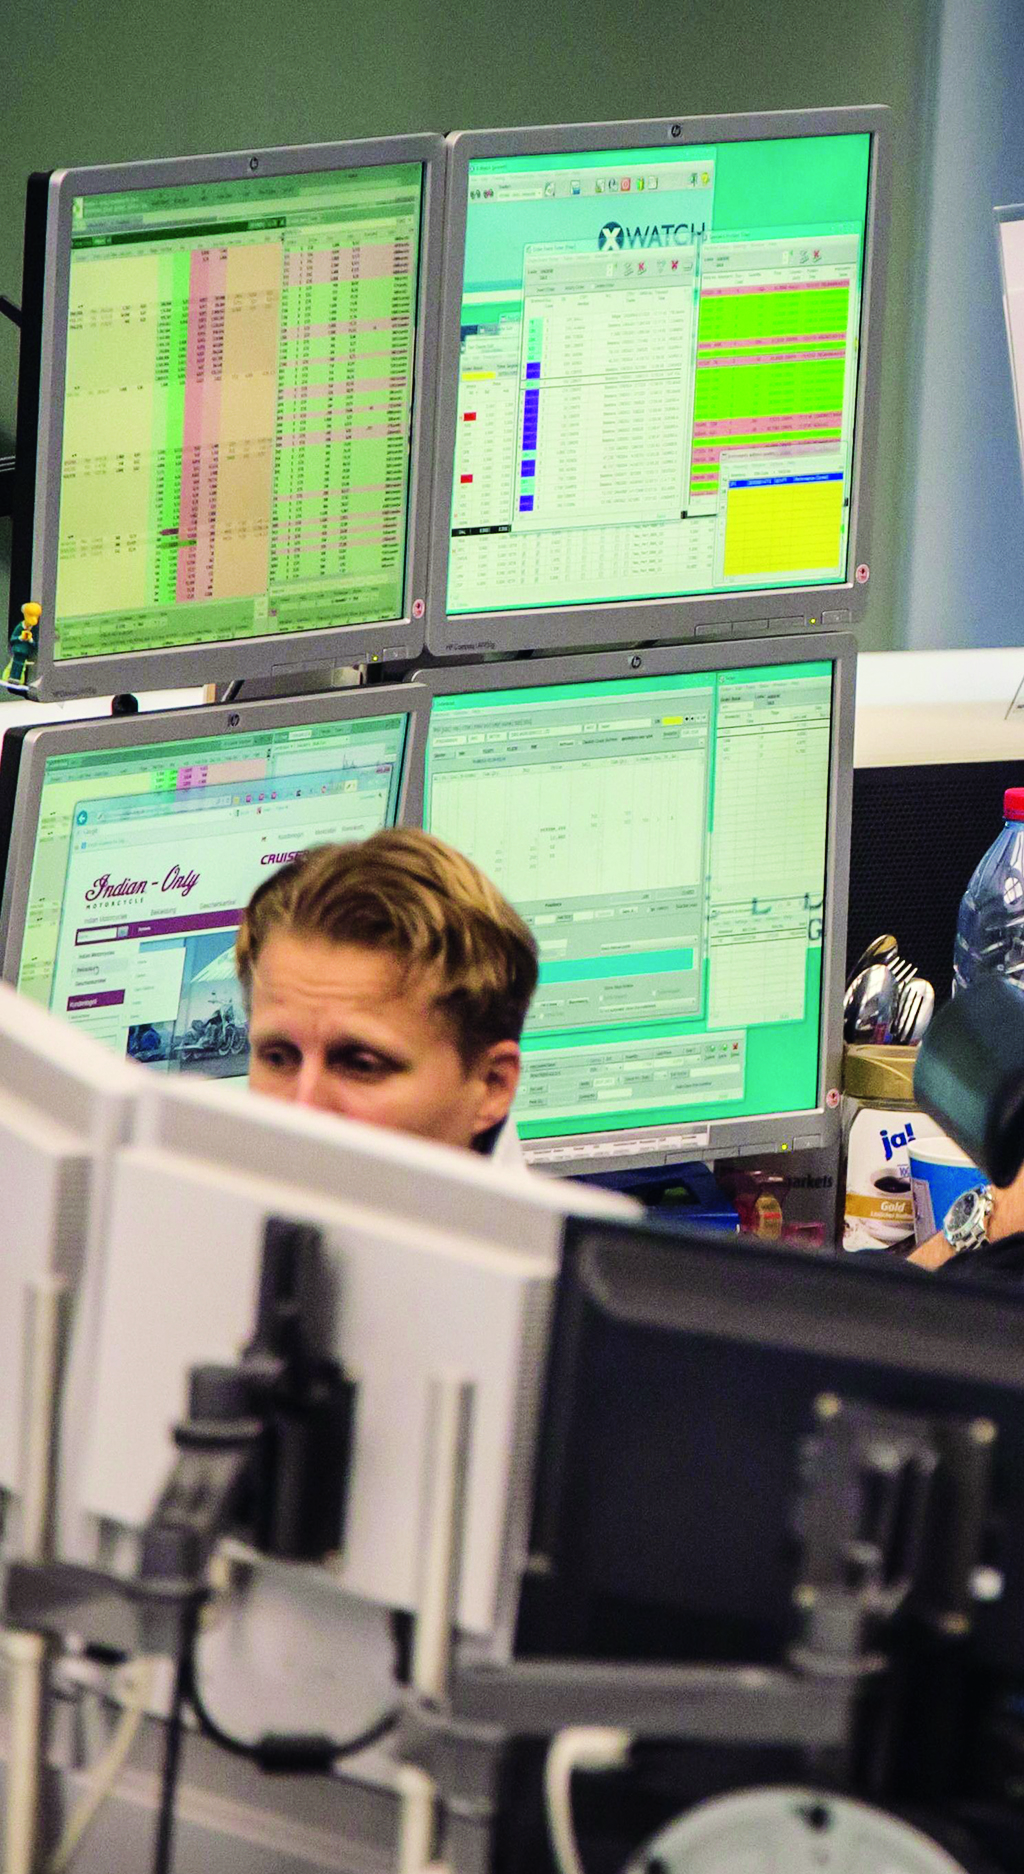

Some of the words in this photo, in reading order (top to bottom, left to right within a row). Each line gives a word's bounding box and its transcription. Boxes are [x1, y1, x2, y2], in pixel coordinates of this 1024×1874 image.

[85, 873, 147, 901] Indian
[161, 864, 200, 897] Only
[86, 898, 144, 910] MOTORCYCLE
[879, 1122, 917, 1162] ja!
[880, 1200, 907, 1214] Gold
